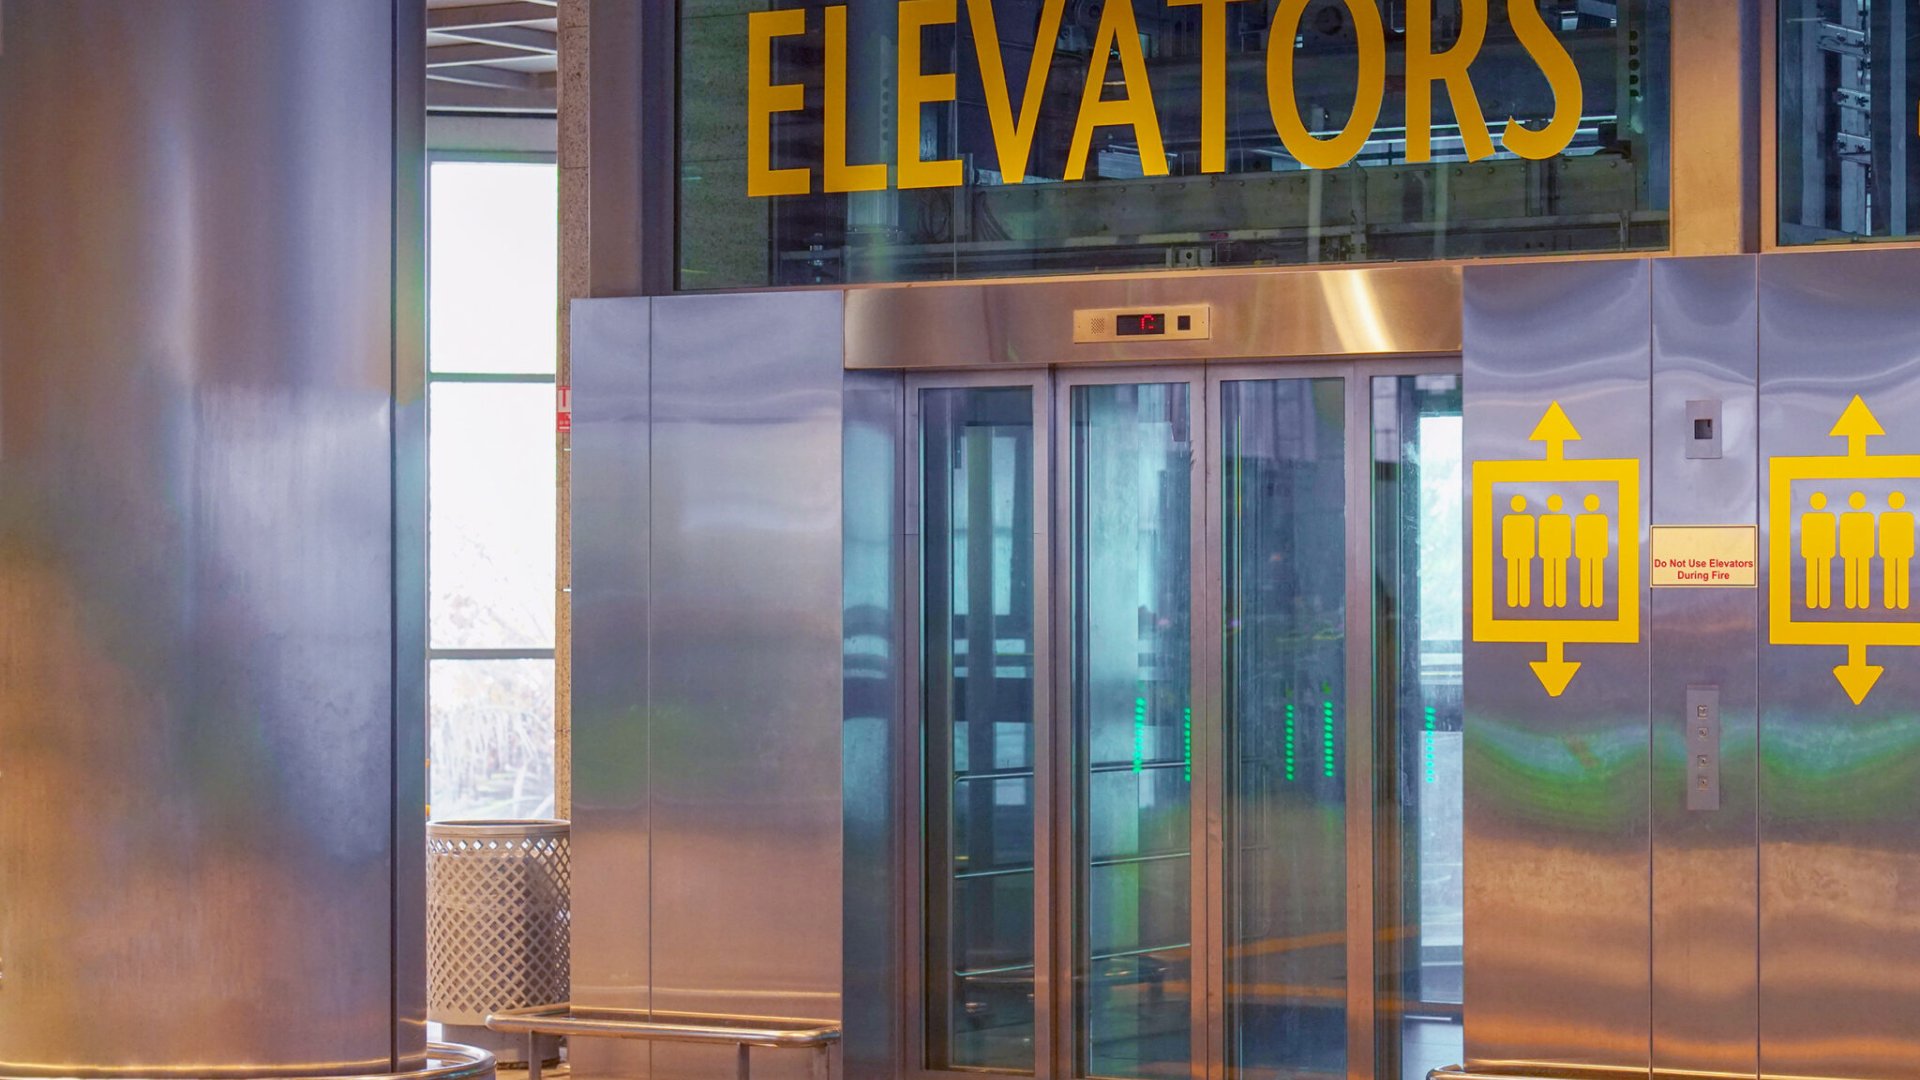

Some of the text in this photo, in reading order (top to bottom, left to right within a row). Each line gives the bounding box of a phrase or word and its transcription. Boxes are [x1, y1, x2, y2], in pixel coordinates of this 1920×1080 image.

[748, 0, 1583, 197] ELEVATORS
[1654, 559, 1753, 568] Do Not Use Elevators
[1678, 570, 1730, 581] During Fire
